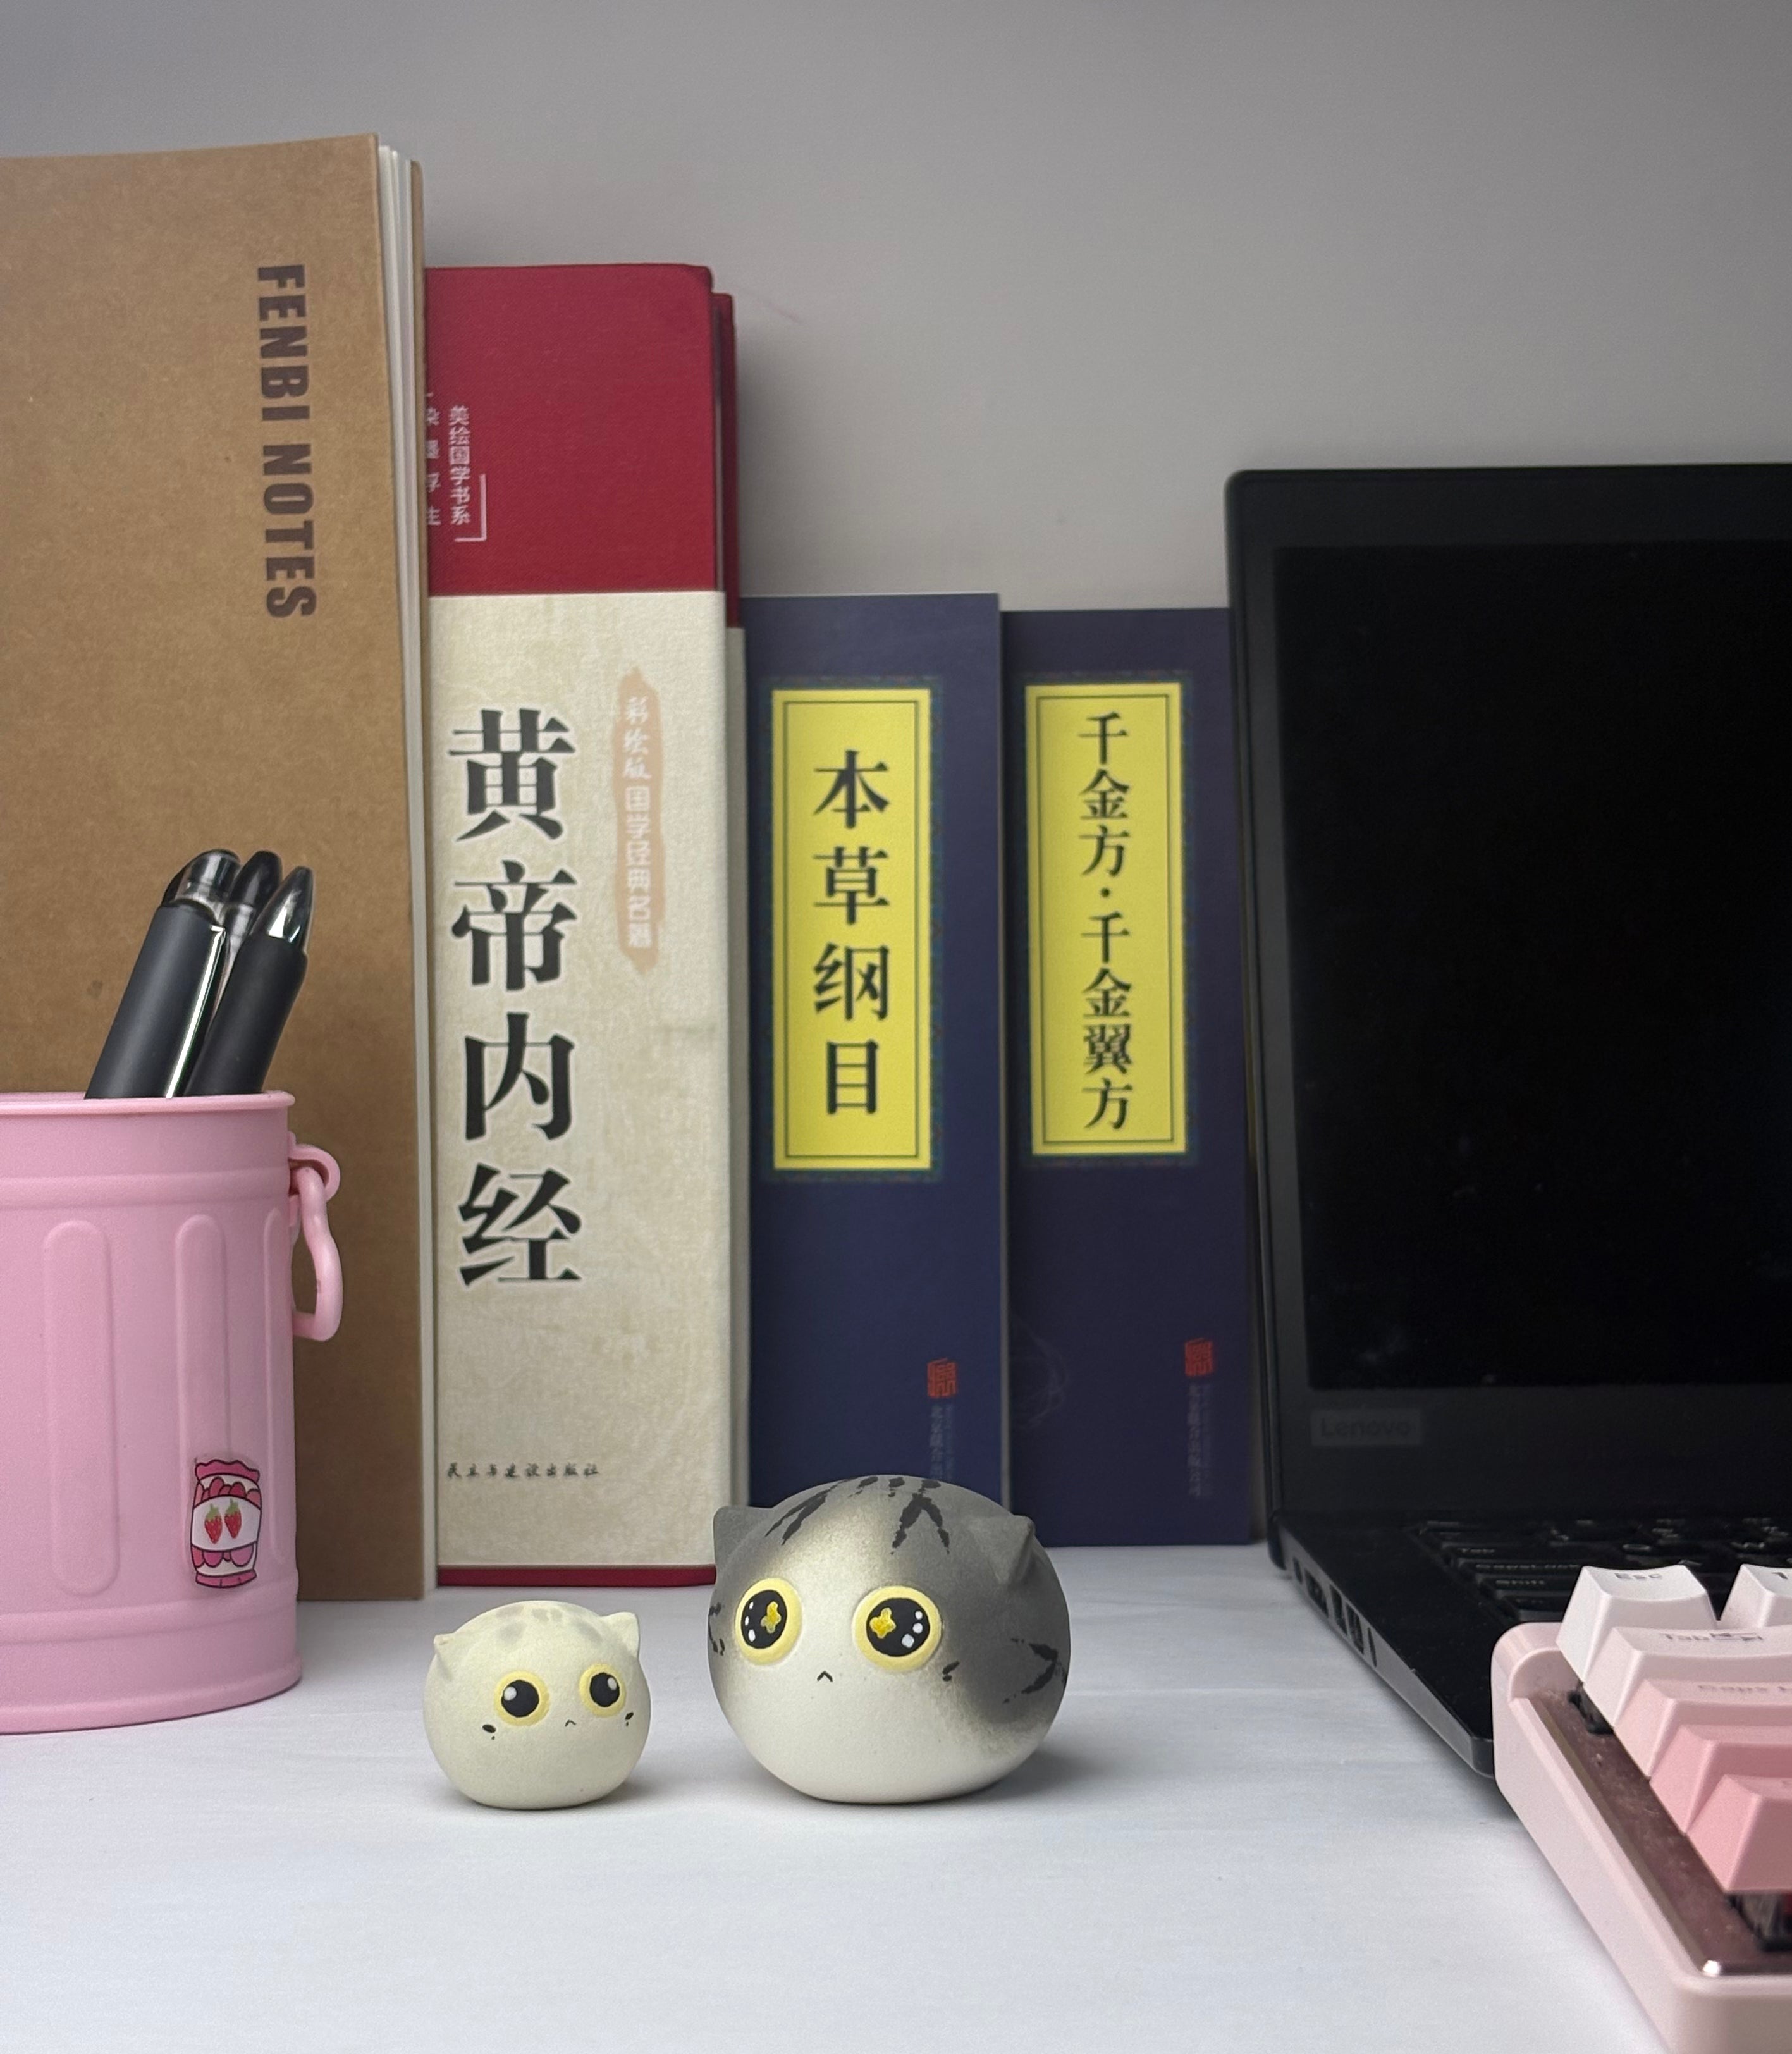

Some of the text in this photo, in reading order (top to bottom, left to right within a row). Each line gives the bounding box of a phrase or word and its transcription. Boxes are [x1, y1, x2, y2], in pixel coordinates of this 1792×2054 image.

[258, 264, 316, 618] FENBI NOTES
[448, 405, 470, 526] 美绘国学书系
[448, 708, 582, 1286] 黄帝内经
[813, 749, 890, 1115] 本草纲目
[1078, 711, 1132, 1131] 千金方·千金翼方
[1320, 1417, 1411, 1437] Lenovo
